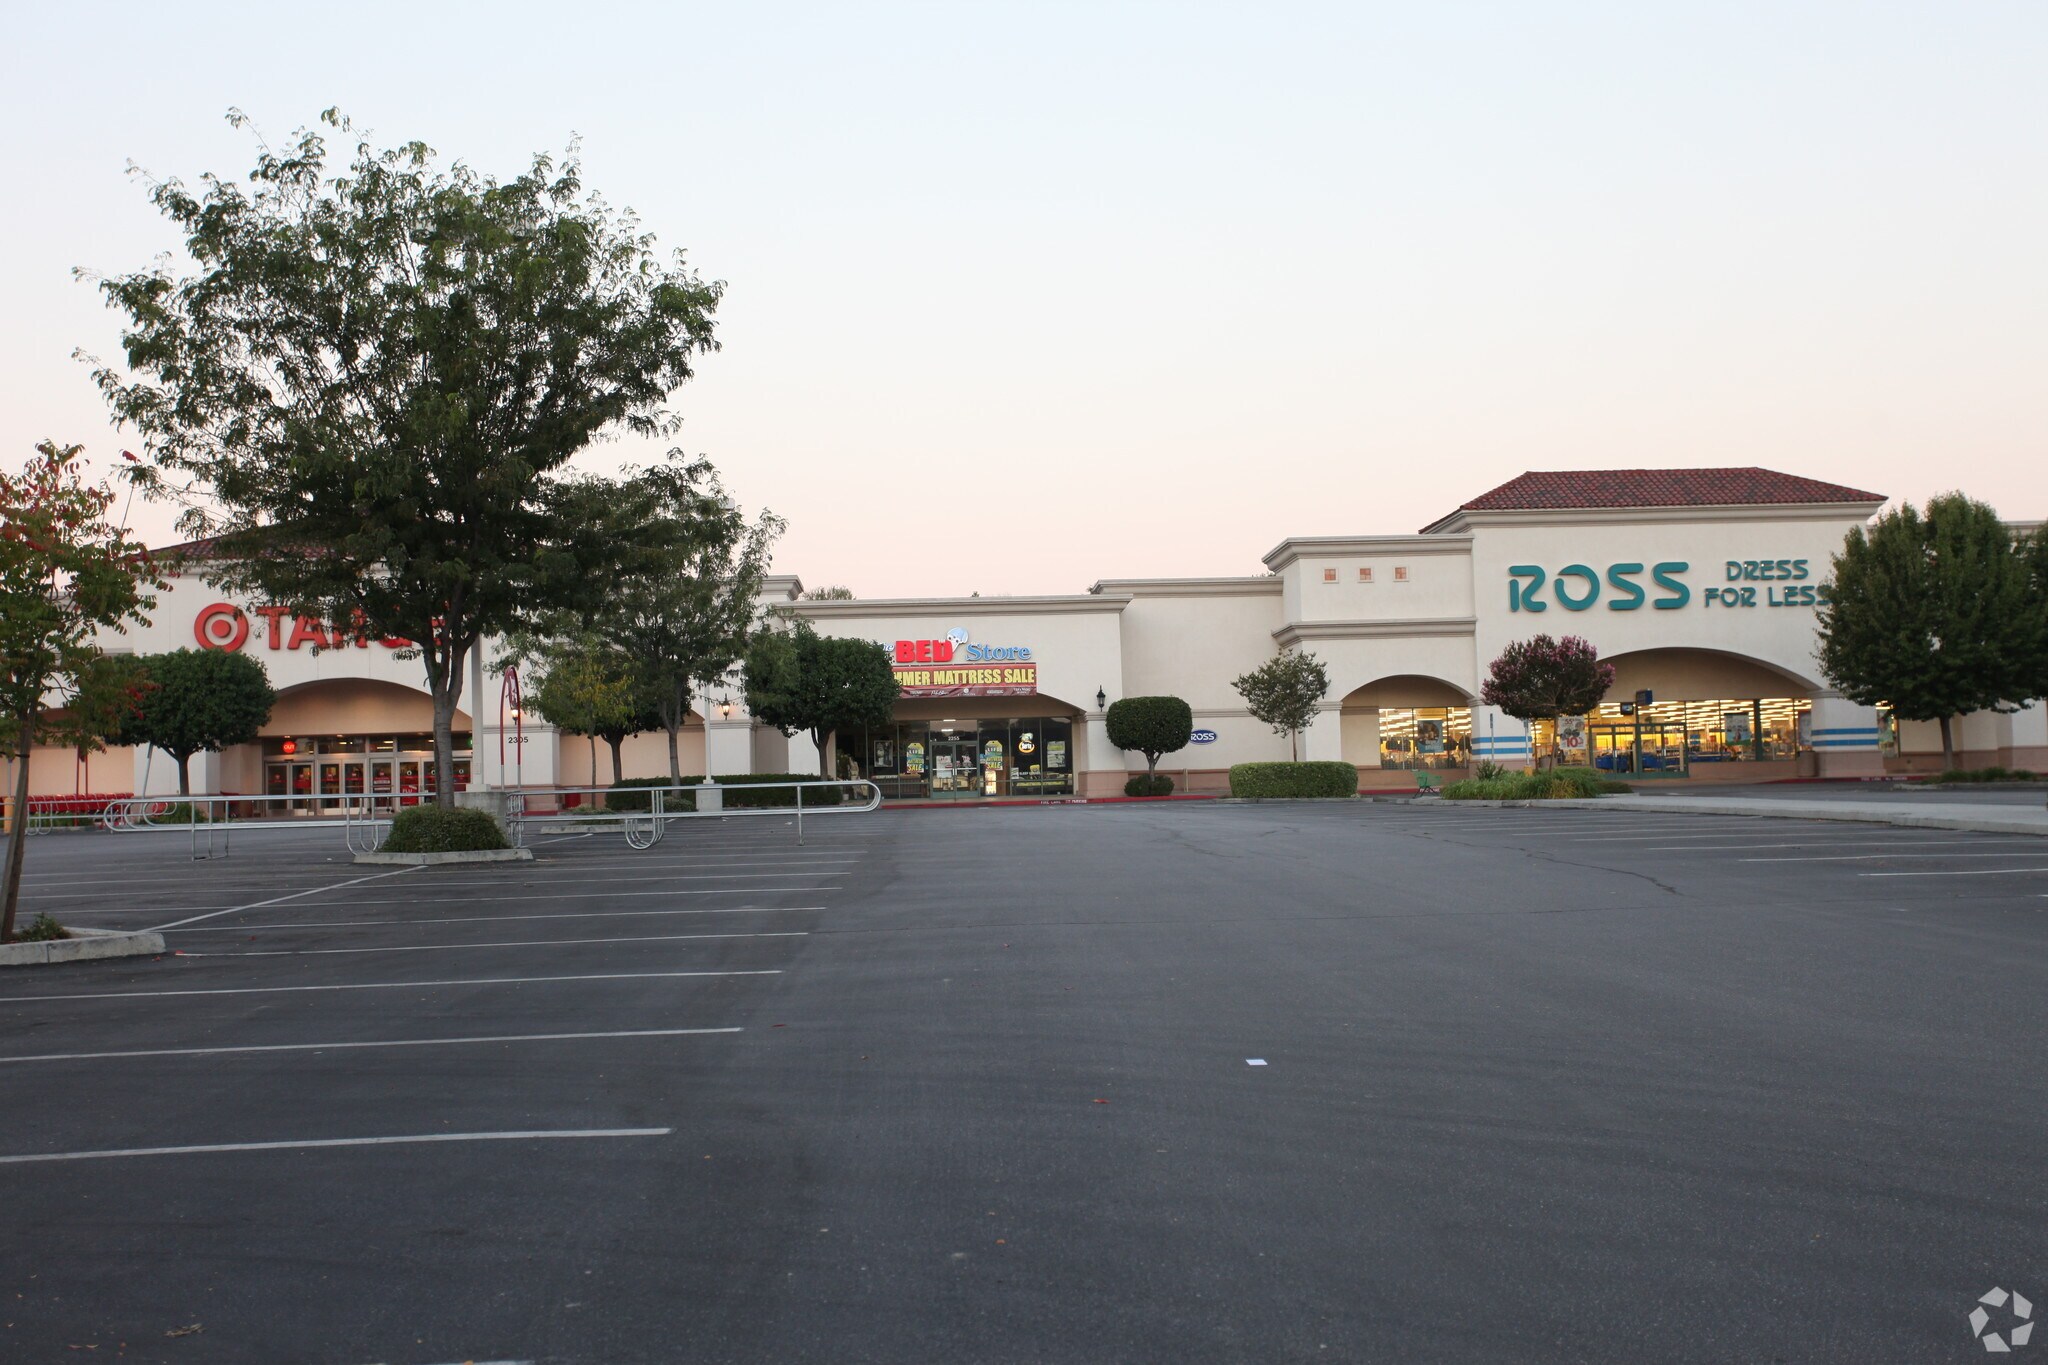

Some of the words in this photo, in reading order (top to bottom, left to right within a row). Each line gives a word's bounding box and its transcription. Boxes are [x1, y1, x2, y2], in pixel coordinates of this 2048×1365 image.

[1726, 559, 1809, 581] DRESS
[1508, 562, 1690, 612] ROSS
[1705, 587, 1757, 608] FOR
[1768, 585, 1833, 607] LESS
[895, 639, 953, 663] BED
[965, 642, 1032, 661] Store
[933, 669, 1001, 685] MATTRESS
[1004, 668, 1035, 684] SALE
[1191, 733, 1215, 741] ROSS
[908, 764, 922, 772] SALE
